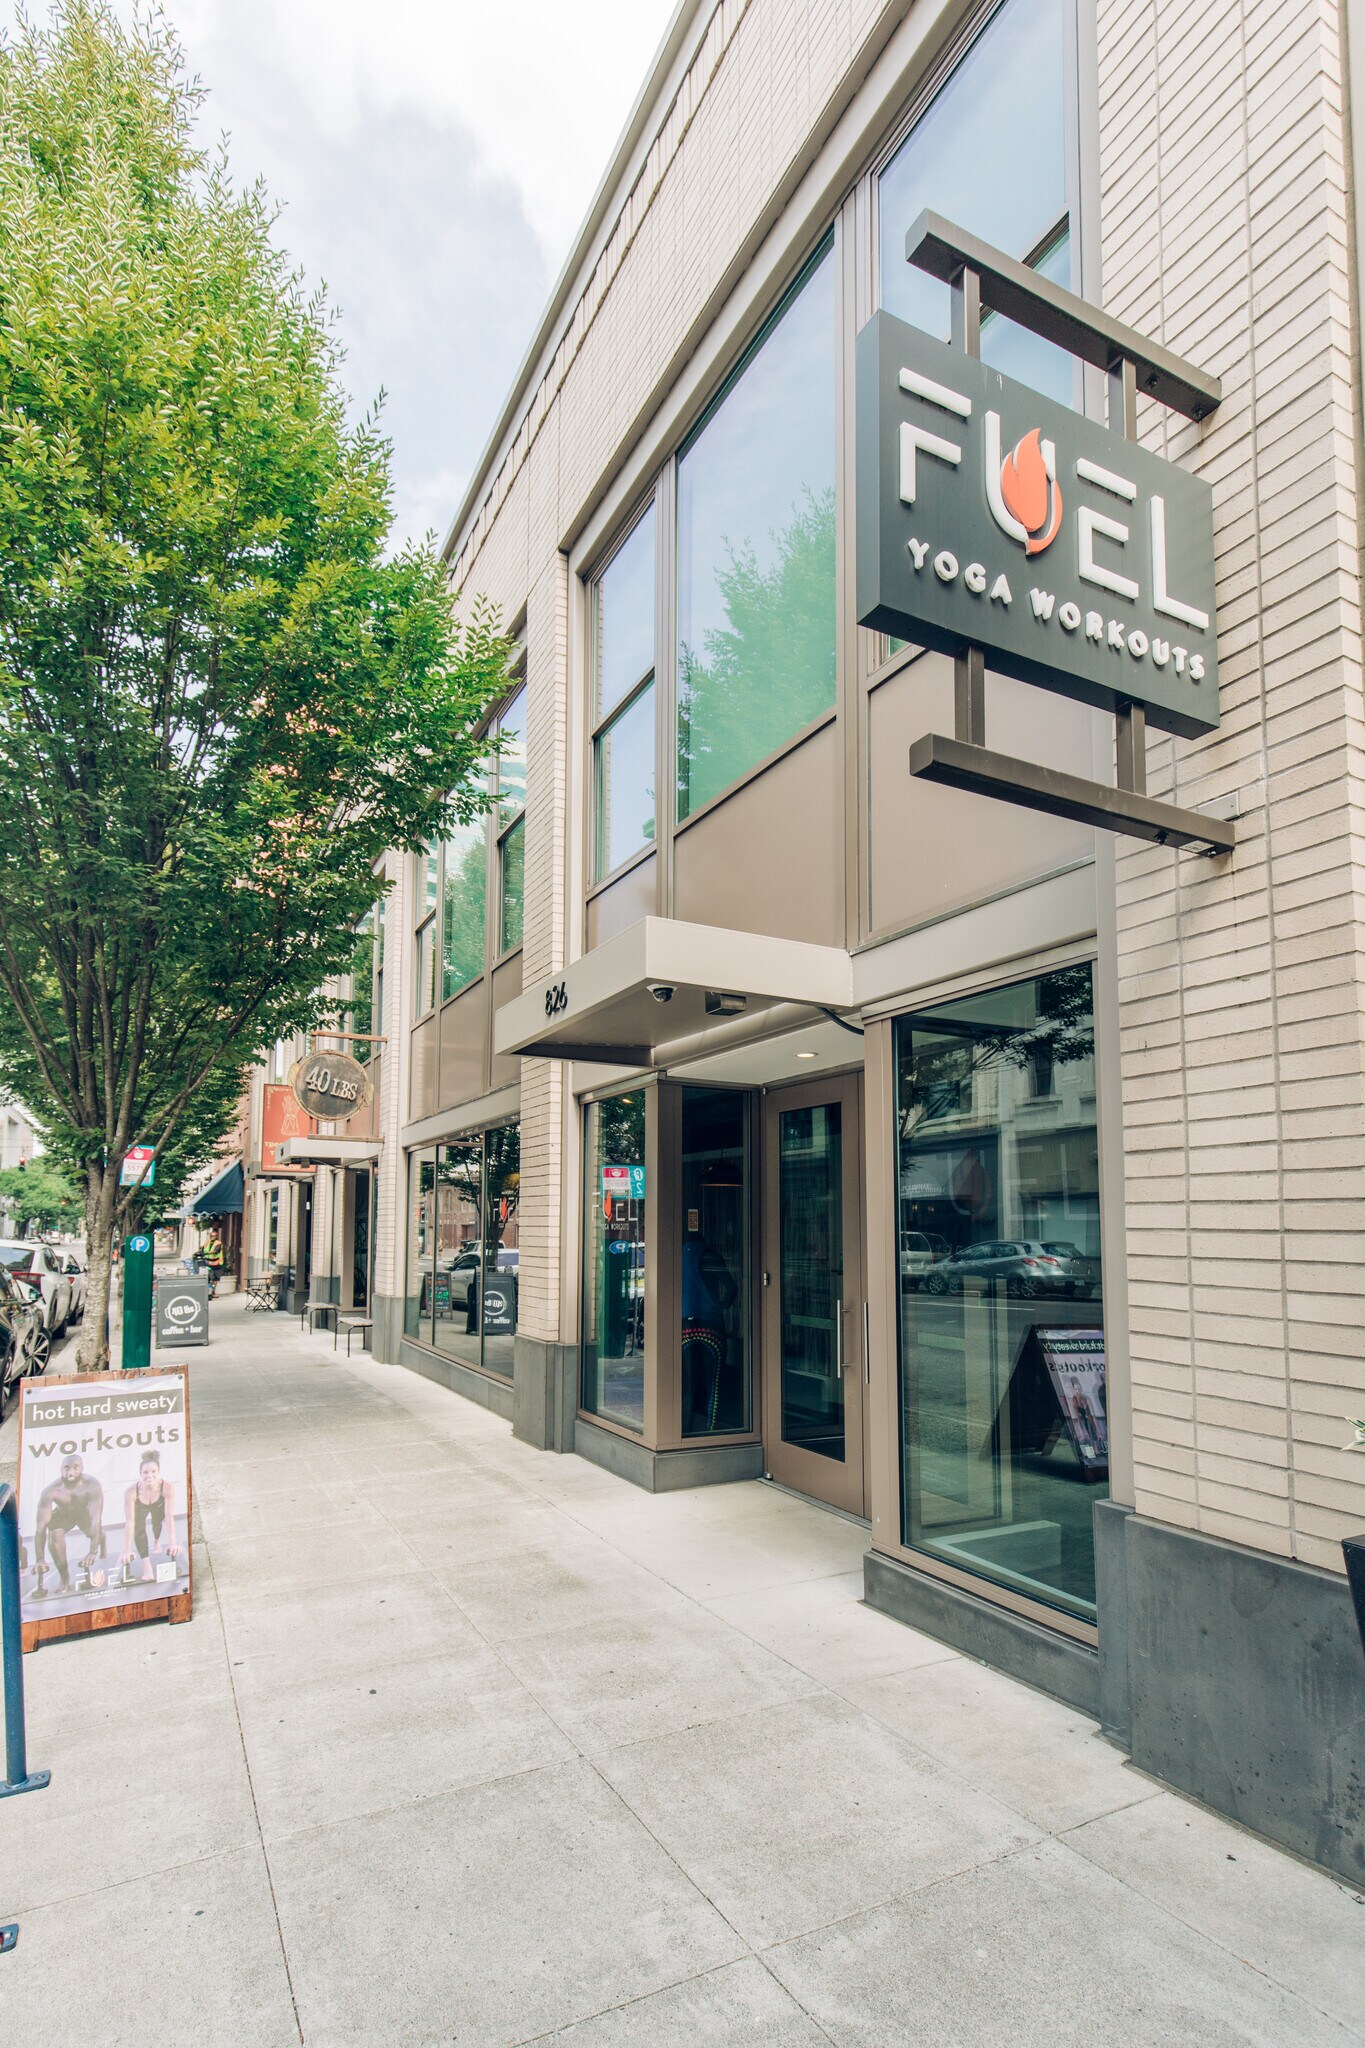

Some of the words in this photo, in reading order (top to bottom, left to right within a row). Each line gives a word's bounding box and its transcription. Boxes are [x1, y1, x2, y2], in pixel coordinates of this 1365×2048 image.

[898, 367, 1209, 630] FUEL
[907, 537, 1013, 605] YOGA
[1029, 587, 1205, 680] WORKOUTS
[545, 981, 568, 1015] 826
[305, 1066, 331, 1093] 40
[330, 1078, 358, 1101] LBS
[171, 1305, 182, 1317] 40
[162, 1325, 184, 1336] coffee
[190, 1324, 203, 1334] bar
[32, 1403, 65, 1421] hot
[70, 1398, 111, 1418] hard
[116, 1394, 178, 1416] sweaty
[27, 1424, 180, 1459] workouts
[75, 1565, 136, 1591] FUEL
